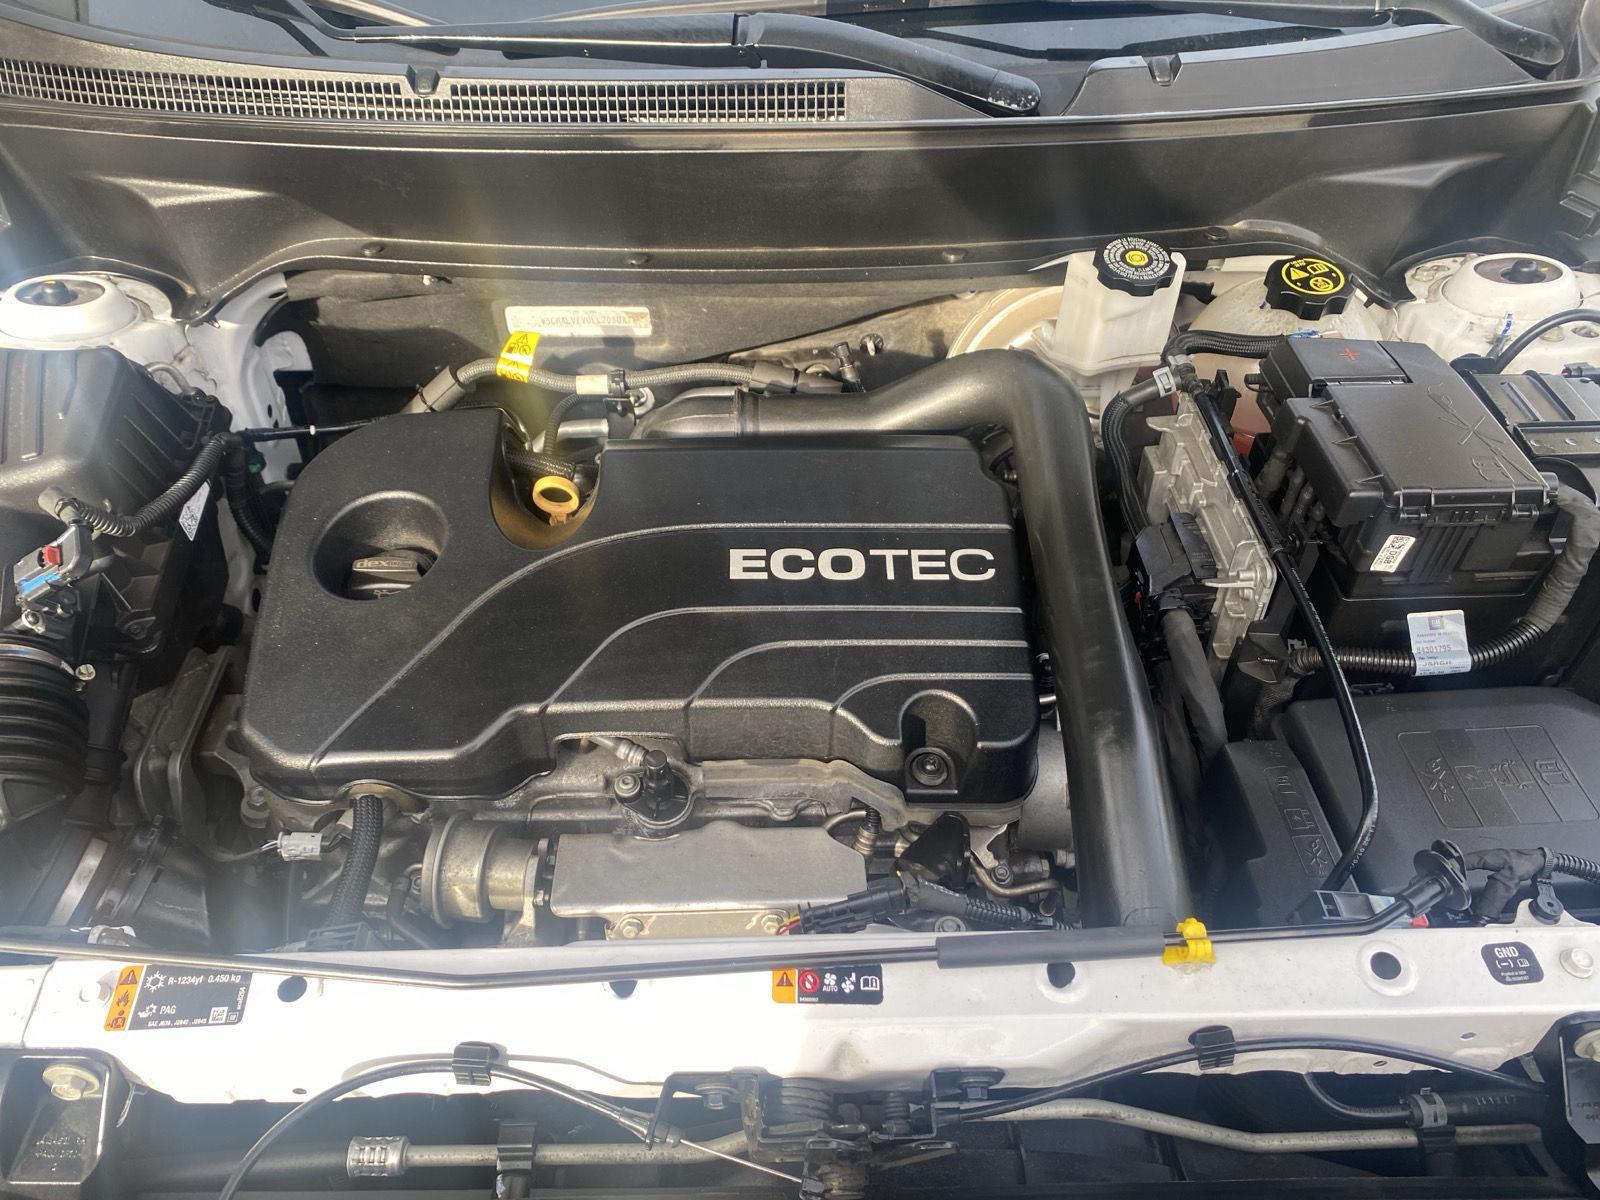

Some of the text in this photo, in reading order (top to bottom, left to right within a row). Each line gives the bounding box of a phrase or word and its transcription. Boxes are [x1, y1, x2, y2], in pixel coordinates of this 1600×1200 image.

[729, 548, 996, 581] ECOTEC
[1495, 946, 1518, 958] GND
[168, 974, 241, 985] R-1234yf 0.450 kg
[160, 1005, 176, 1014] PAG
